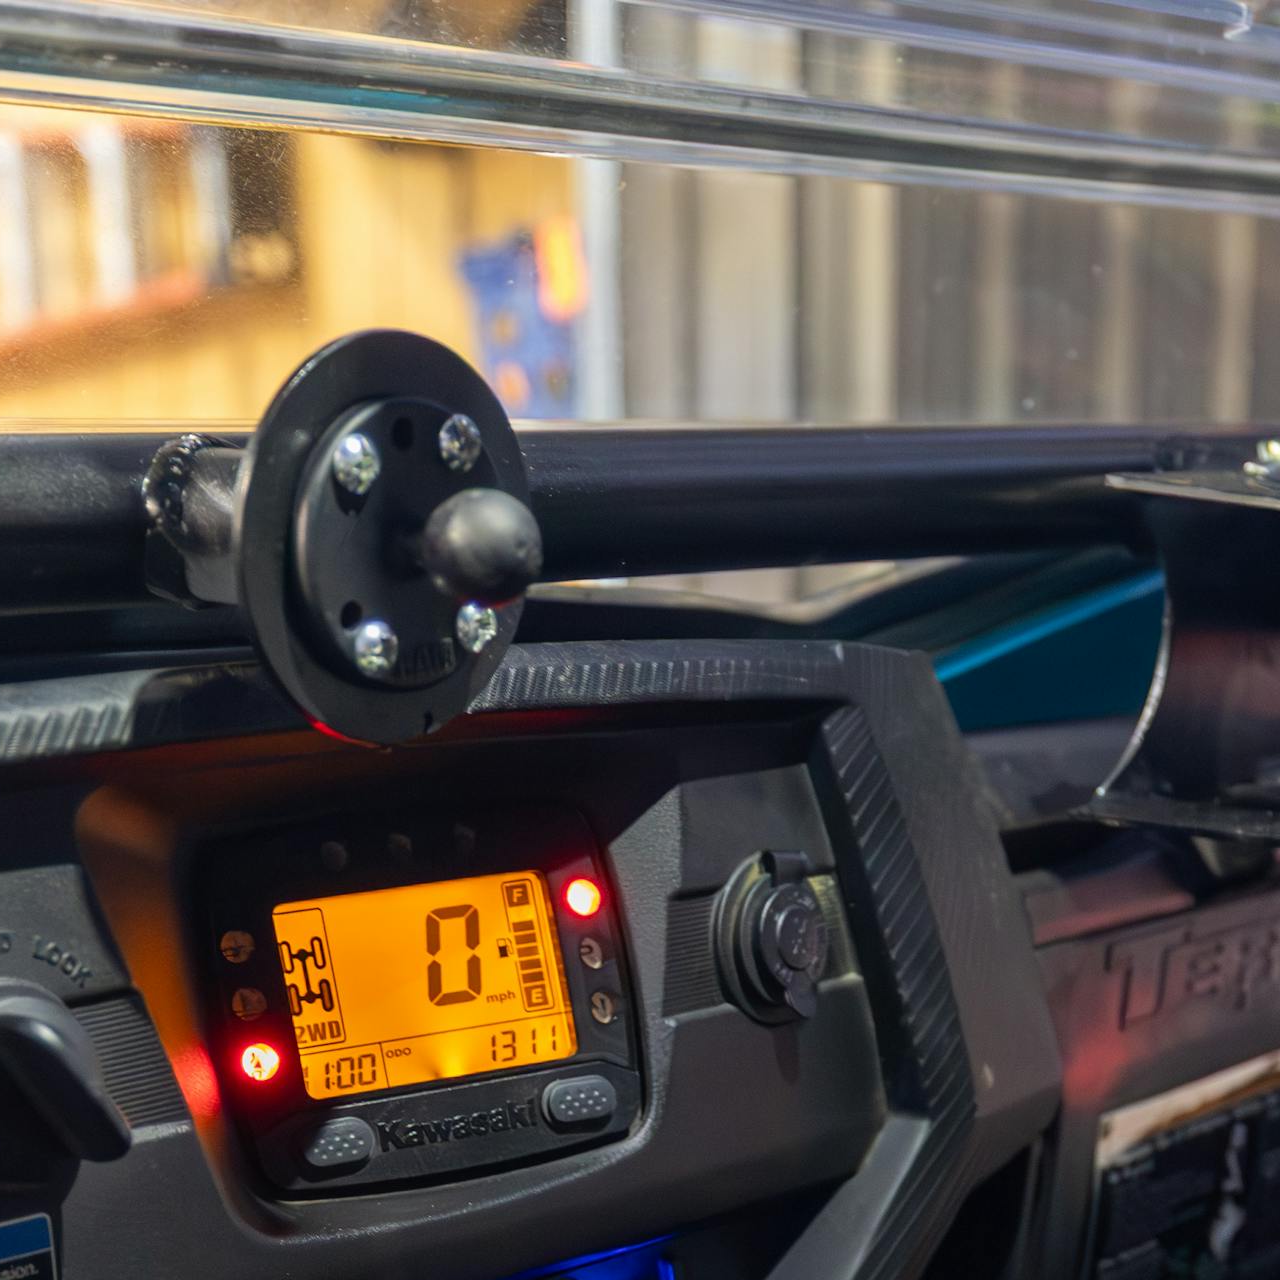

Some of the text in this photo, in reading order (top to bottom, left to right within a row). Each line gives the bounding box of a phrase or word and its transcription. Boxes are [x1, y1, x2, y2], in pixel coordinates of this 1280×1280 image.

[426, 904, 482, 1007] 0
[486, 989, 517, 1004] mph
[295, 1020, 341, 1044] 2WD
[491, 1025, 558, 1062] 1311
[385, 1047, 412, 1059] ODO
[376, 1096, 538, 1152] Kawasaki
